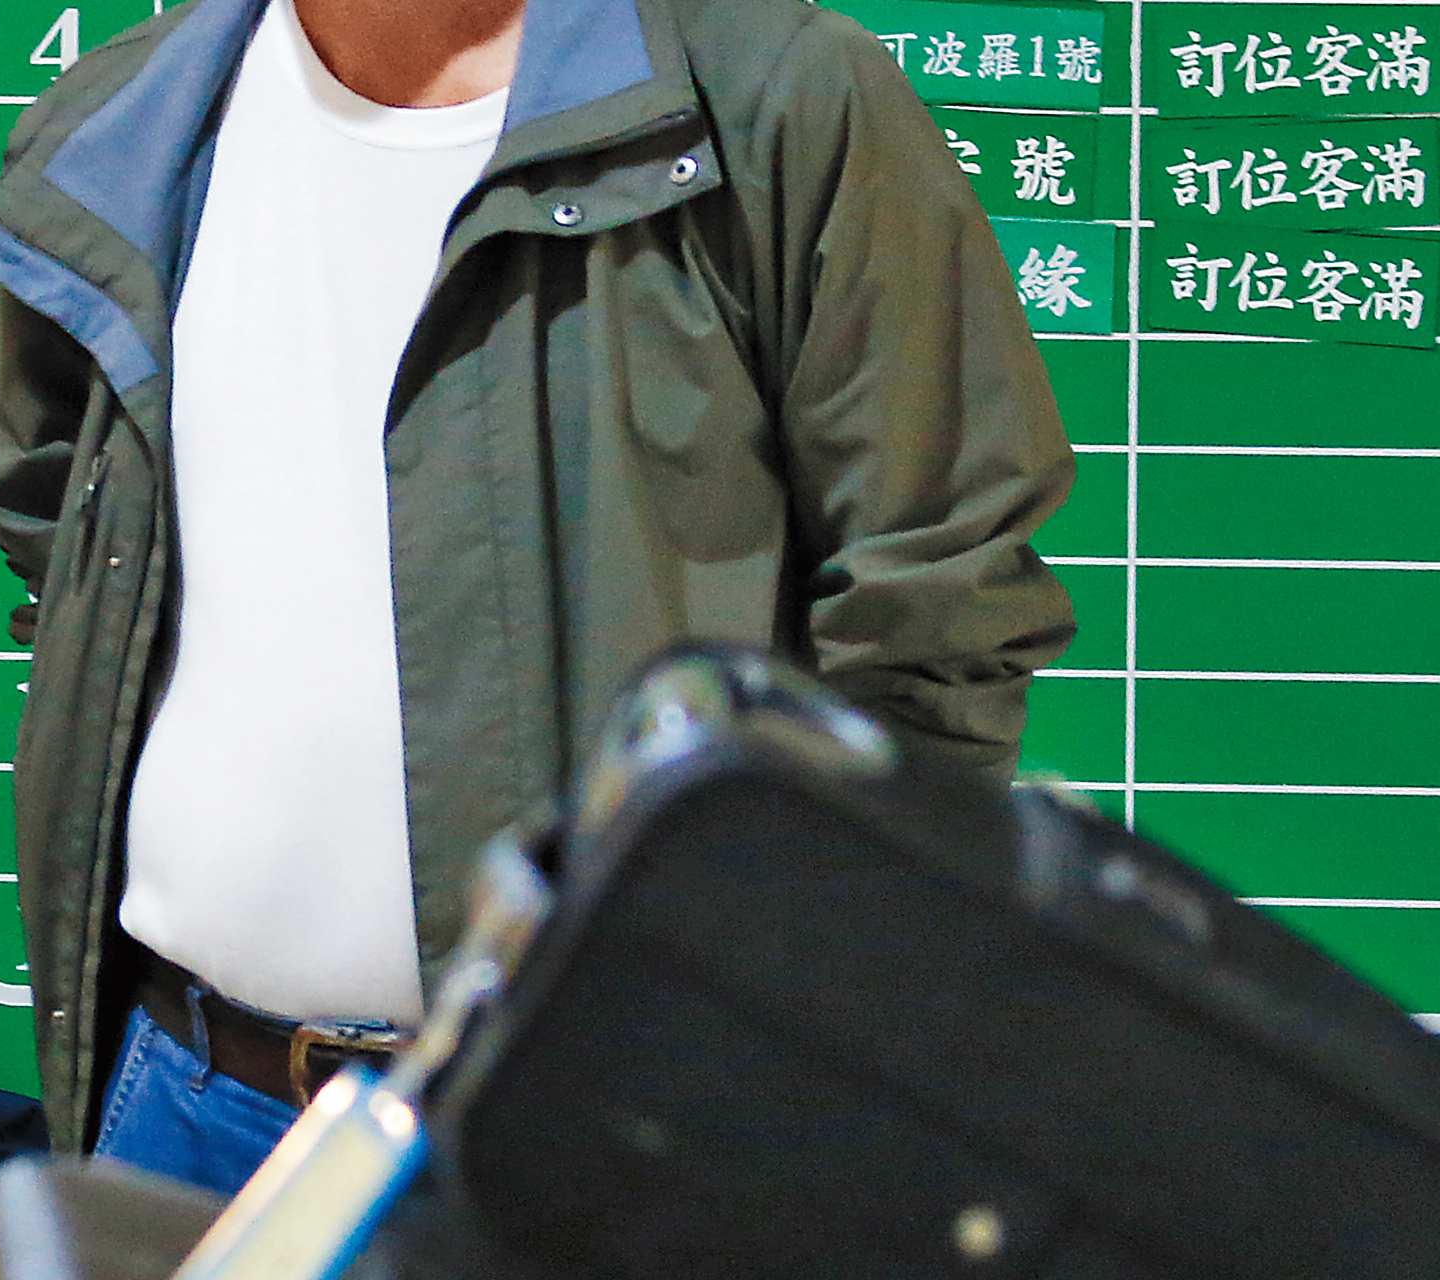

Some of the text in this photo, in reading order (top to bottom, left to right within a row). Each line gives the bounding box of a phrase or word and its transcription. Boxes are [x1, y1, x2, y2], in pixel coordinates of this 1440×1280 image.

[1170, 26, 1430, 97] 訂位客滿
[1166, 139, 1425, 214] 訂位客滿
[1169, 243, 1424, 329] 訂位客滿
